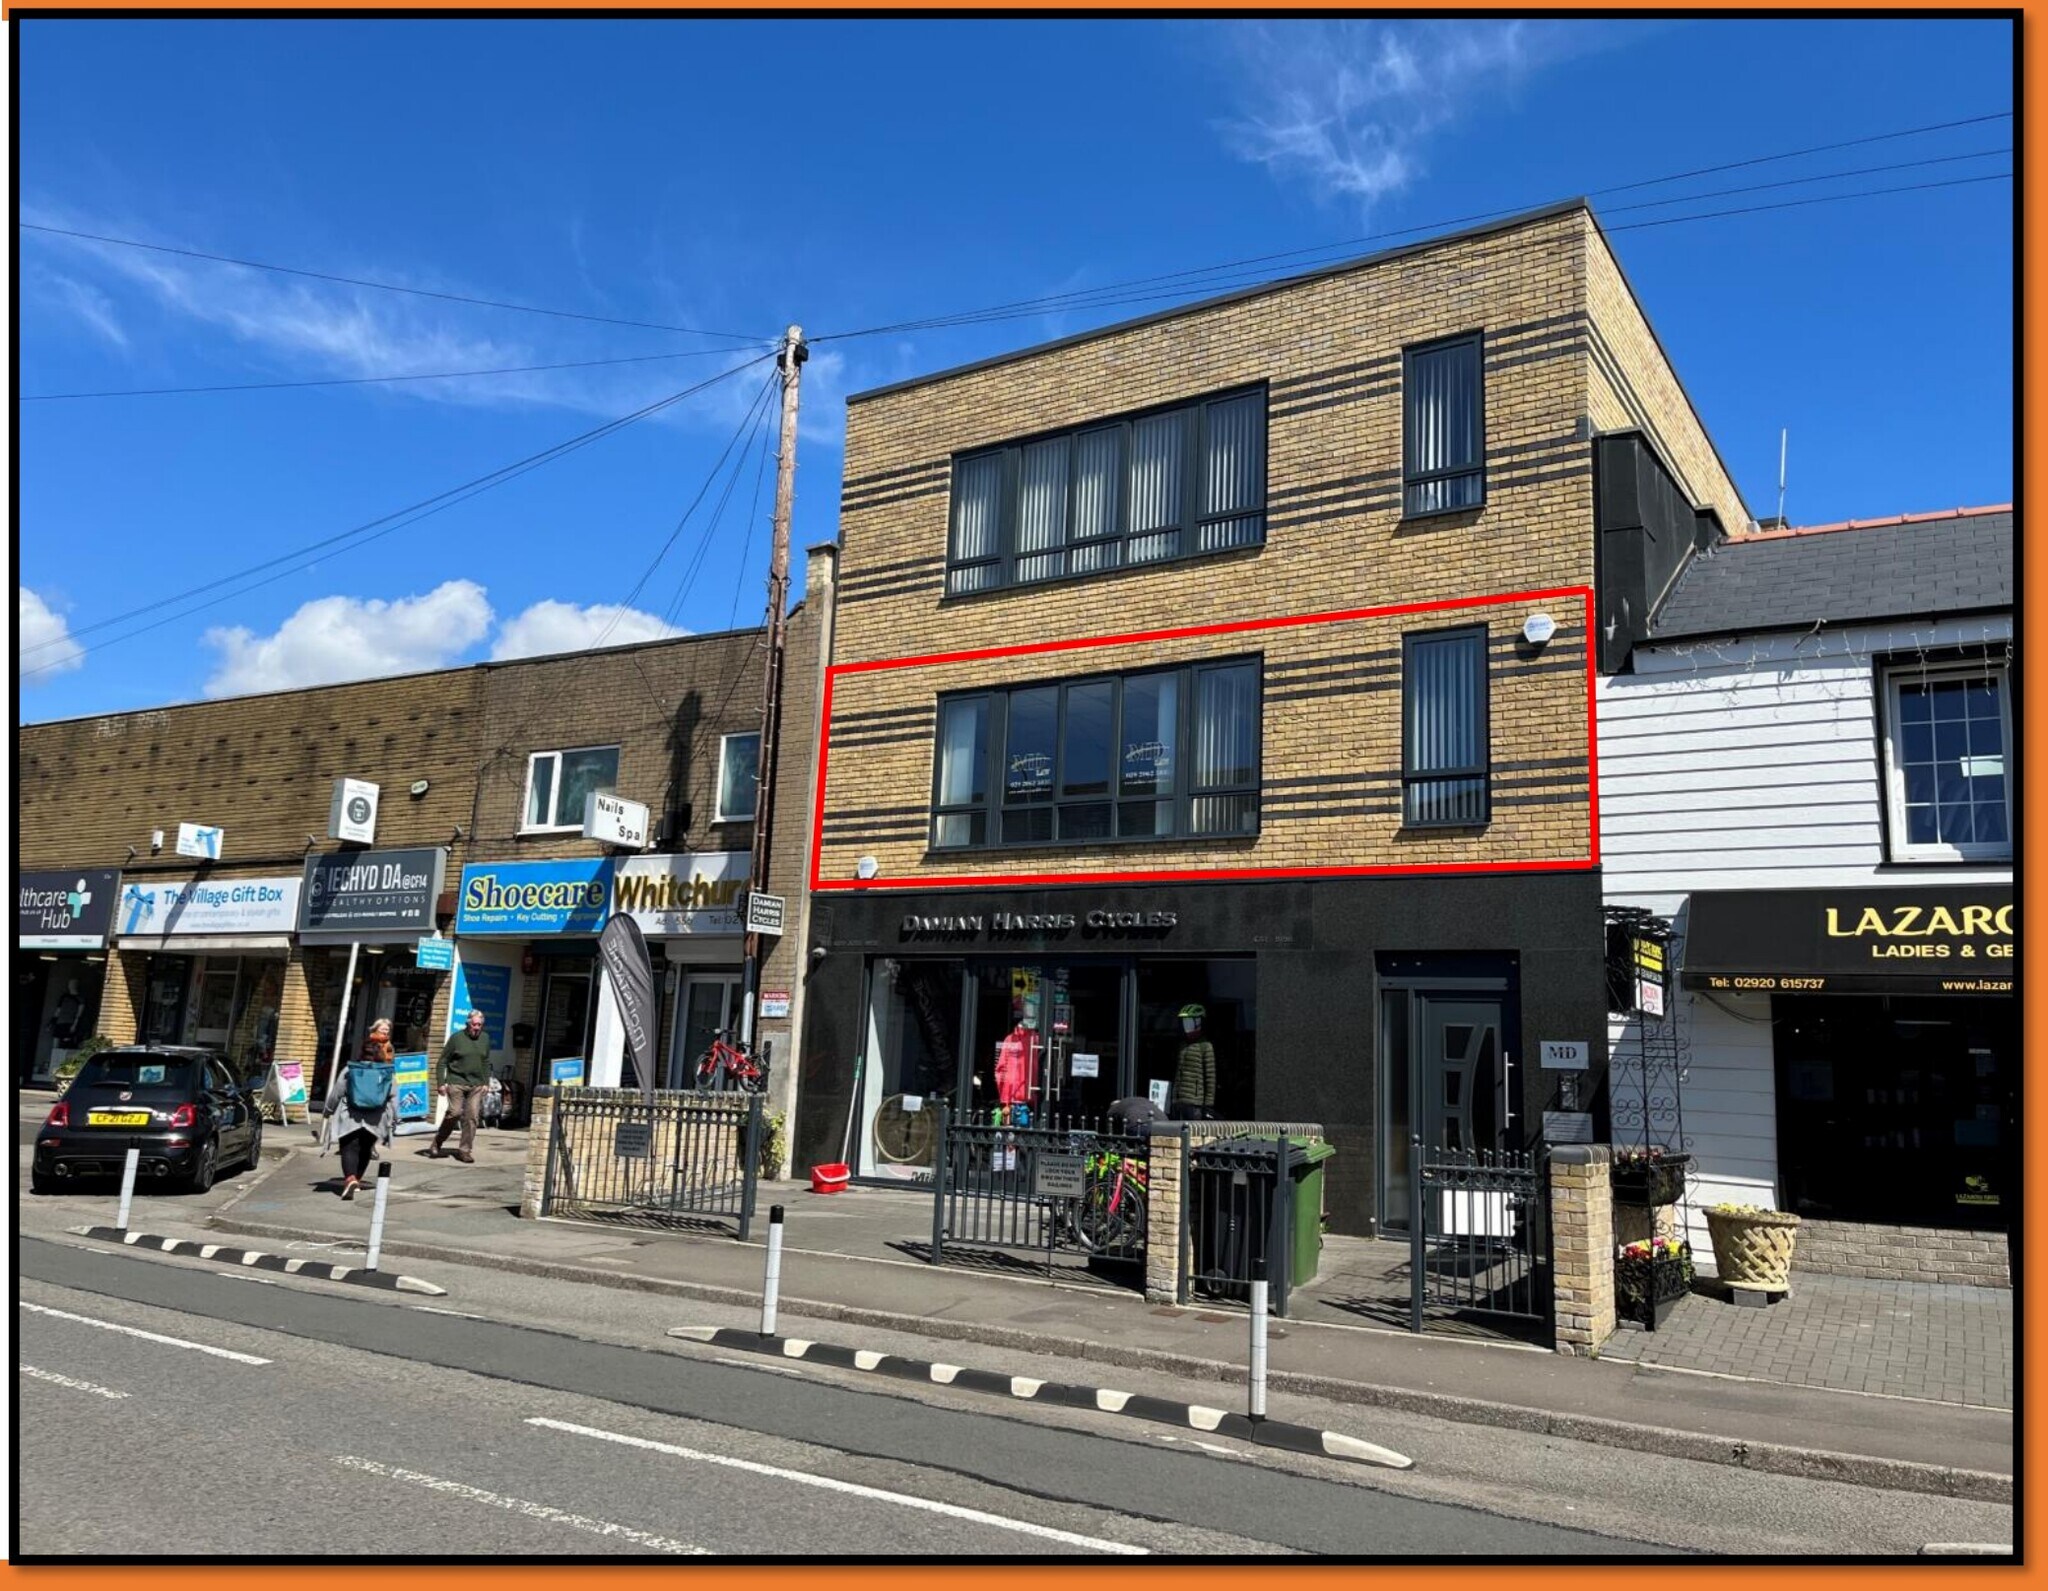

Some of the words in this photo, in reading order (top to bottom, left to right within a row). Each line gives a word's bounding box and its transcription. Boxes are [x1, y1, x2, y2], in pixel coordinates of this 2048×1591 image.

[598, 798, 624, 815] Nails
[618, 825, 640, 841] Spa
[327, 864, 379, 892] IECHYD
[381, 863, 401, 890] DA
[164, 890, 186, 905] The
[188, 888, 229, 907] Village
[231, 884, 256, 903] Gift
[257, 886, 283, 902] Box
[375, 895, 426, 905] OPTIONS
[465, 875, 605, 911] Shoecare
[752, 896, 781, 909] DAMIAN
[463, 914, 481, 922] Shoe
[482, 913, 508, 923] Repairs
[516, 913, 529, 923] Key
[531, 912, 557, 922] Cutting
[752, 905, 780, 917] HARRIS
[41, 908, 70, 929] Hub
[751, 914, 780, 926] CYCLES
[902, 915, 983, 931] DAMIAN
[992, 912, 1076, 930] HARRIS
[1086, 910, 1178, 928] CYCLES
[1872, 944, 1951, 958] LADIES
[1960, 944, 1976, 958] &
[1985, 944, 2013, 958] GE
[1709, 976, 1730, 988] Tel:
[1734, 977, 1775, 989] 02920
[1780, 978, 1824, 989] 615737
[1548, 1046, 1577, 1060] MD
